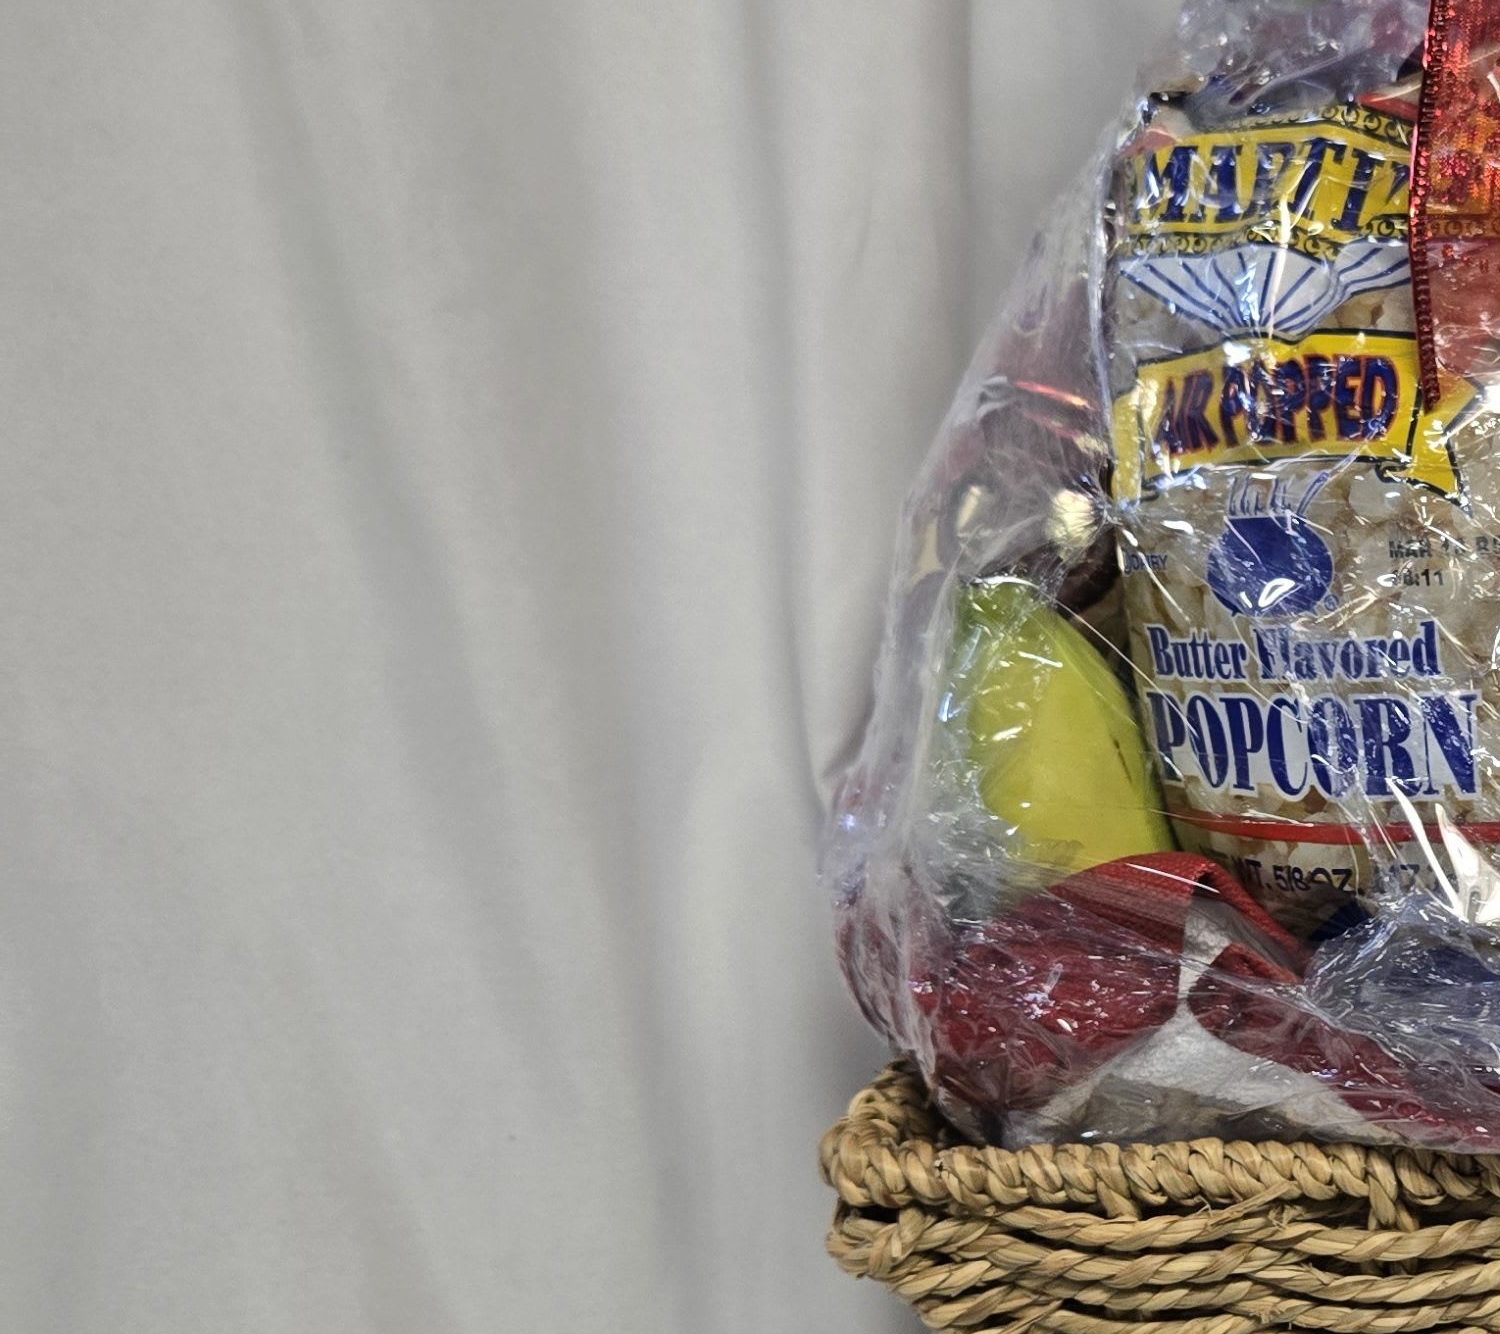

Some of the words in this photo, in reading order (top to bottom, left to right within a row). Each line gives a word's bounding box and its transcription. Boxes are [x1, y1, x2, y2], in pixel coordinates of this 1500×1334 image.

[1219, 353, 1400, 449] POPPED
[1144, 624, 1249, 681] Butter
[1251, 619, 1444, 681] Flavored
[1145, 690, 1479, 799] POPCORN
